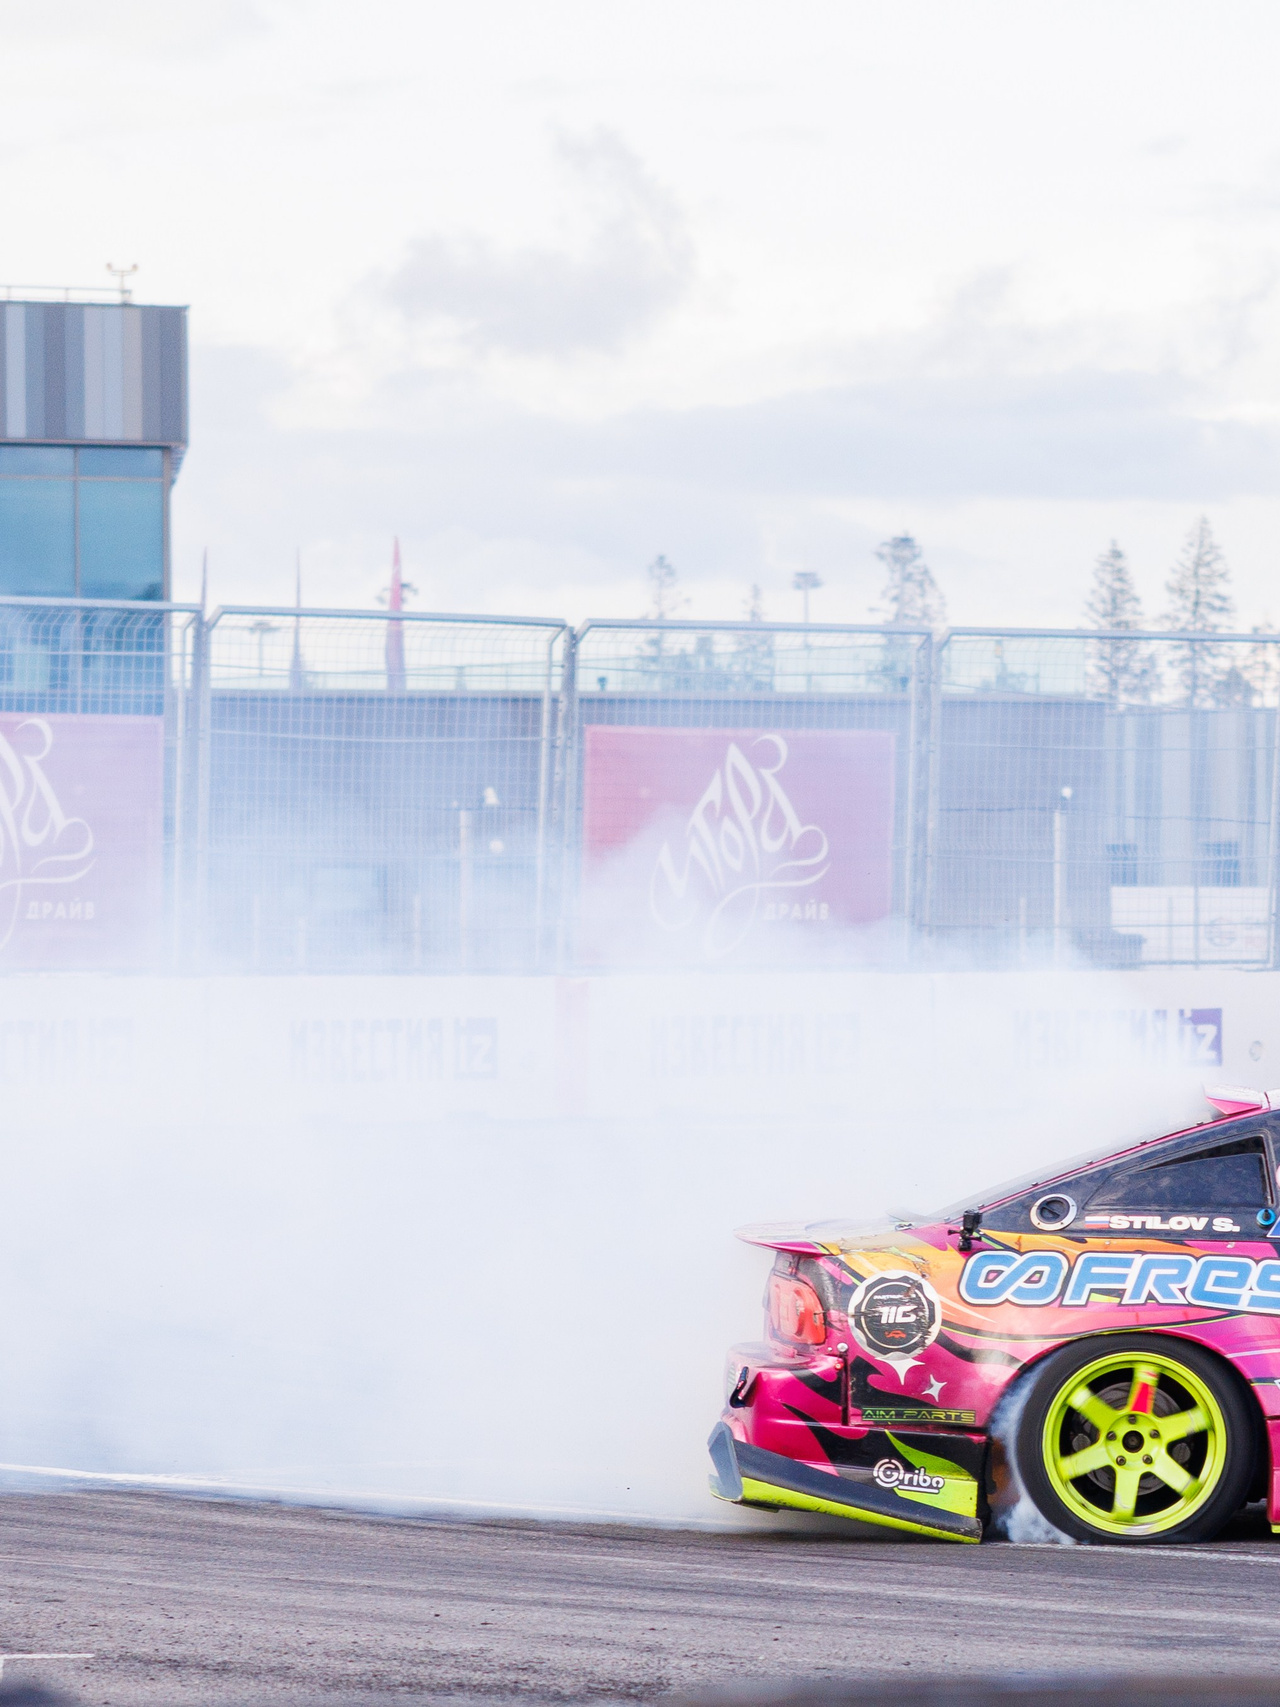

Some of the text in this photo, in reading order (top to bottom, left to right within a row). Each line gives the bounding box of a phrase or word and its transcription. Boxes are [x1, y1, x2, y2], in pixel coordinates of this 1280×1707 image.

[25, 896, 95, 921] ДРАЙВ
[763, 899, 829, 920] ДРАЙВ
[1109, 1216, 1240, 1232] STILOV S.
[863, 1409, 976, 1423] AIM PARTS
